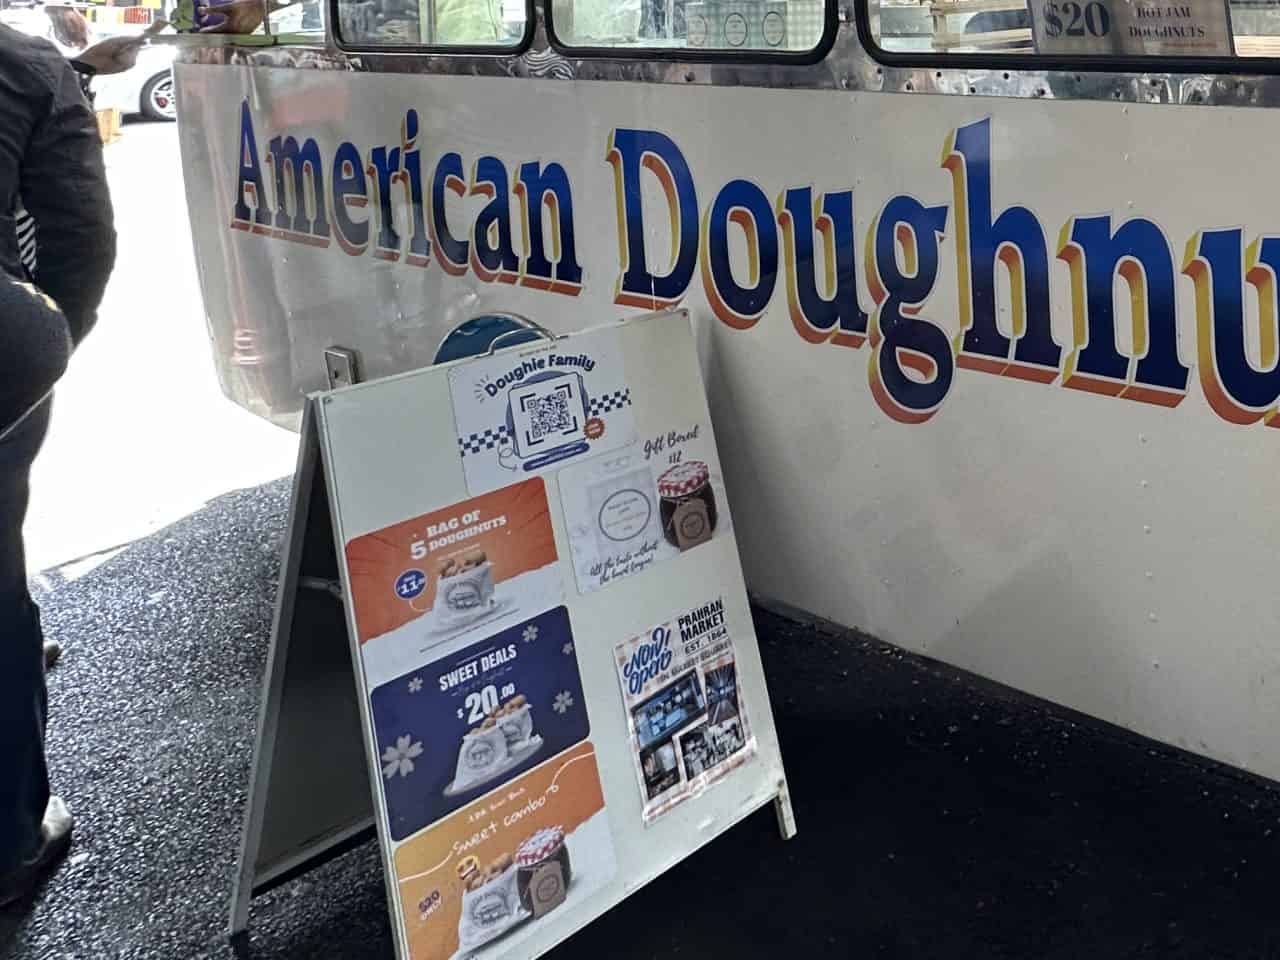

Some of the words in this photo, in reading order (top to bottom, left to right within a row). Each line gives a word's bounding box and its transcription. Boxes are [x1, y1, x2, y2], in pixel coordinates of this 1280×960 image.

[1043, 1, 1110, 37] $20
[1137, 7, 1162, 19] HOT
[1164, 6, 1192, 18] JAM
[1128, 24, 1208, 38] DOUGHNUTS
[231, 96, 583, 297] American
[485, 357, 545, 397] Doughie
[549, 354, 595, 372] Family
[410, 540, 427, 560] 5
[429, 515, 507, 551] DOUGHNUTS
[426, 517, 459, 539] BAG
[462, 510, 481, 523] OF
[678, 599, 722, 629] PRAHRAN
[680, 610, 725, 642] MARKET
[439, 661, 478, 691] SWEET
[481, 644, 517, 672] DEALS
[419, 890, 440, 913] $20
